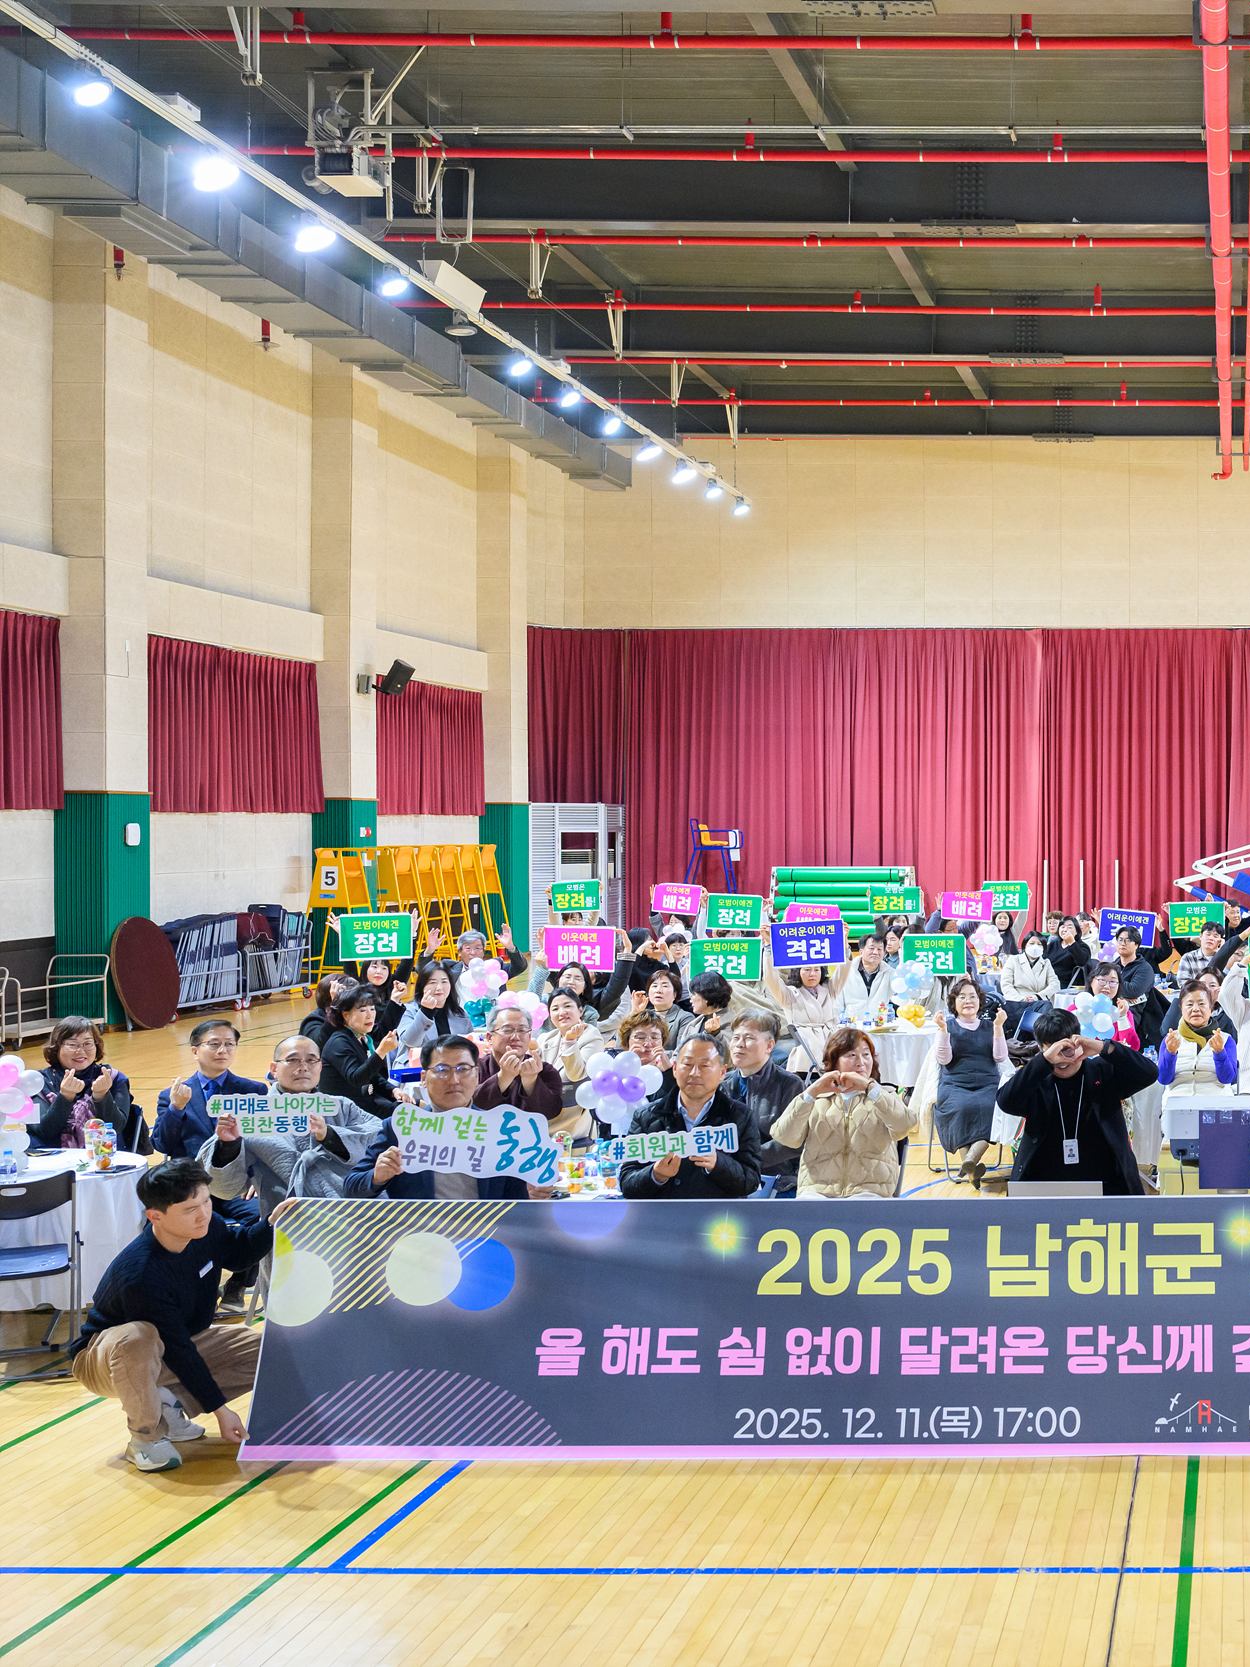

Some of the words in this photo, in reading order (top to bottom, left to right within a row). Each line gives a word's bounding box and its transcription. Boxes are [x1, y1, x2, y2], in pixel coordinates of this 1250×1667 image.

[324, 871, 336, 886] 5
[663, 895, 692, 911] 배려
[952, 901, 983, 917] 배려
[353, 920, 399, 930] 모범이에겐
[718, 909, 751, 926] 장려
[779, 925, 835, 937] 어려운이에겐
[354, 932, 398, 954] 장려
[703, 943, 749, 952] 모범이에겐
[787, 938, 830, 960] 격려
[557, 945, 600, 965] 배려
[704, 955, 747, 975] 장려
[916, 951, 953, 970] 장려
[210, 1097, 270, 1115] #미래로
[274, 1096, 336, 1114] 나아가는
[396, 1107, 444, 1136] 함께
[452, 1114, 488, 1141] 걷는
[495, 1111, 558, 1184] 동행
[612, 1134, 687, 1160] #회원과
[693, 1127, 735, 1154] 함께
[402, 1139, 457, 1168] 우리의
[467, 1145, 486, 1173] 길
[757, 1228, 953, 1296] 2025
[986, 1218, 1222, 1297] 남해군
[534, 1327, 586, 1376] 올
[601, 1324, 700, 1376] 해도
[718, 1326, 767, 1376] 쉼
[785, 1326, 881, 1376] 없이
[900, 1326, 1049, 1375] 달려온
[1066, 1324, 1213, 1374] 당신께
[733, 1407, 830, 1439] 2025.
[842, 1407, 884, 1439] 12.
[895, 1405, 983, 1440] 11.(목)
[993, 1406, 1081, 1438] 17:00
